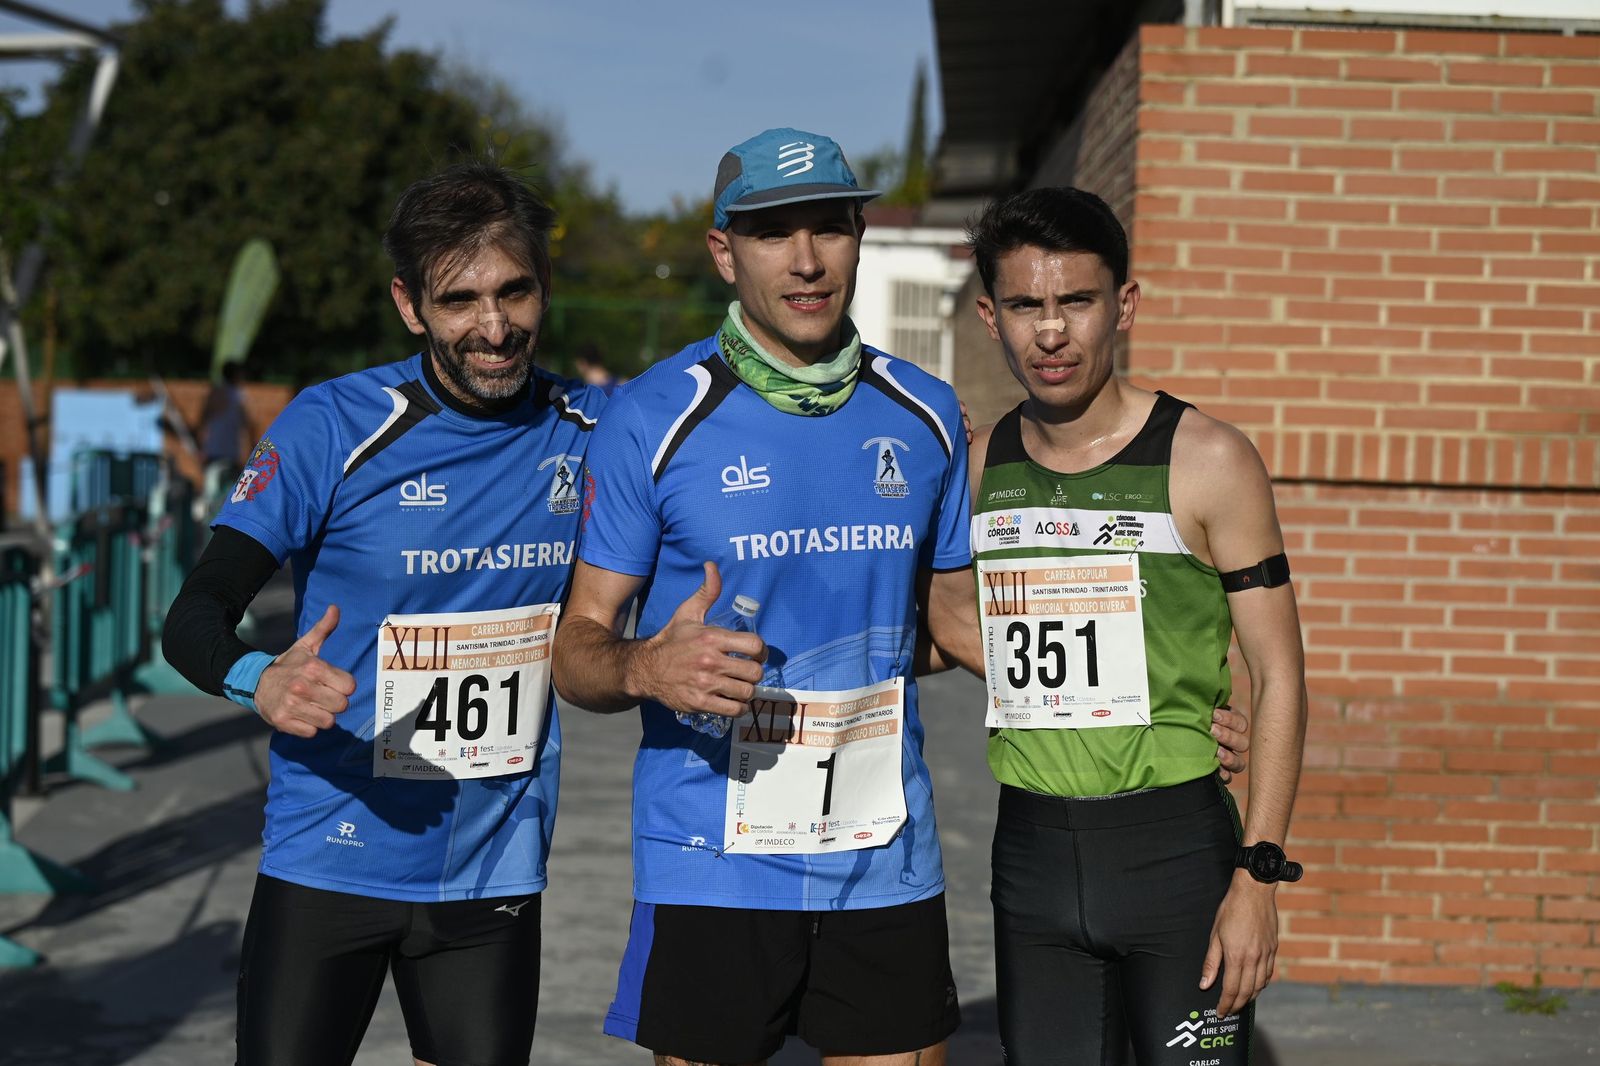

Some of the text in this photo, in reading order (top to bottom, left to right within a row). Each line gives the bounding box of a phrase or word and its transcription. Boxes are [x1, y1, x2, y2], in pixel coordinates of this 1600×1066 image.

[721, 455, 771, 493] als
[399, 472, 448, 506] als
[995, 488, 1027, 499] IMDECO
[988, 527, 1020, 538] CÓRDOBA
[1114, 529, 1127, 537] AIRE
[729, 524, 914, 561] TROTASIERRA
[1113, 537, 1138, 547] CAC
[1044, 568, 1108, 581] CARRERA POPULAR
[985, 571, 1029, 616] XLII
[1032, 587, 1060, 595] SANTISIMA
[1061, 586, 1088, 594] TRINIDAD
[1092, 585, 1129, 593] TRINITARIOS
[1029, 602, 1065, 614] MEMORIAL
[471, 618, 535, 637] CARRERA POPULAR
[387, 626, 451, 671] XLII
[456, 642, 489, 651] SANTISIMA
[490, 639, 516, 648] TRINIDAD
[1006, 619, 1099, 690] 351
[450, 656, 491, 670] MEMORIAL
[415, 670, 520, 742] 461
[828, 701, 857, 716] CARRERA
[743, 699, 808, 745] XLII
[812, 720, 843, 728] SANTISIMA
[865, 709, 894, 720] TRINITARIOS
[816, 752, 837, 816] 1
[326, 835, 365, 848] RUNOPRO
[764, 838, 796, 846] IMDECO
[1201, 1023, 1239, 1036] AIRE SPORT
[1200, 1034, 1234, 1049] CAC
